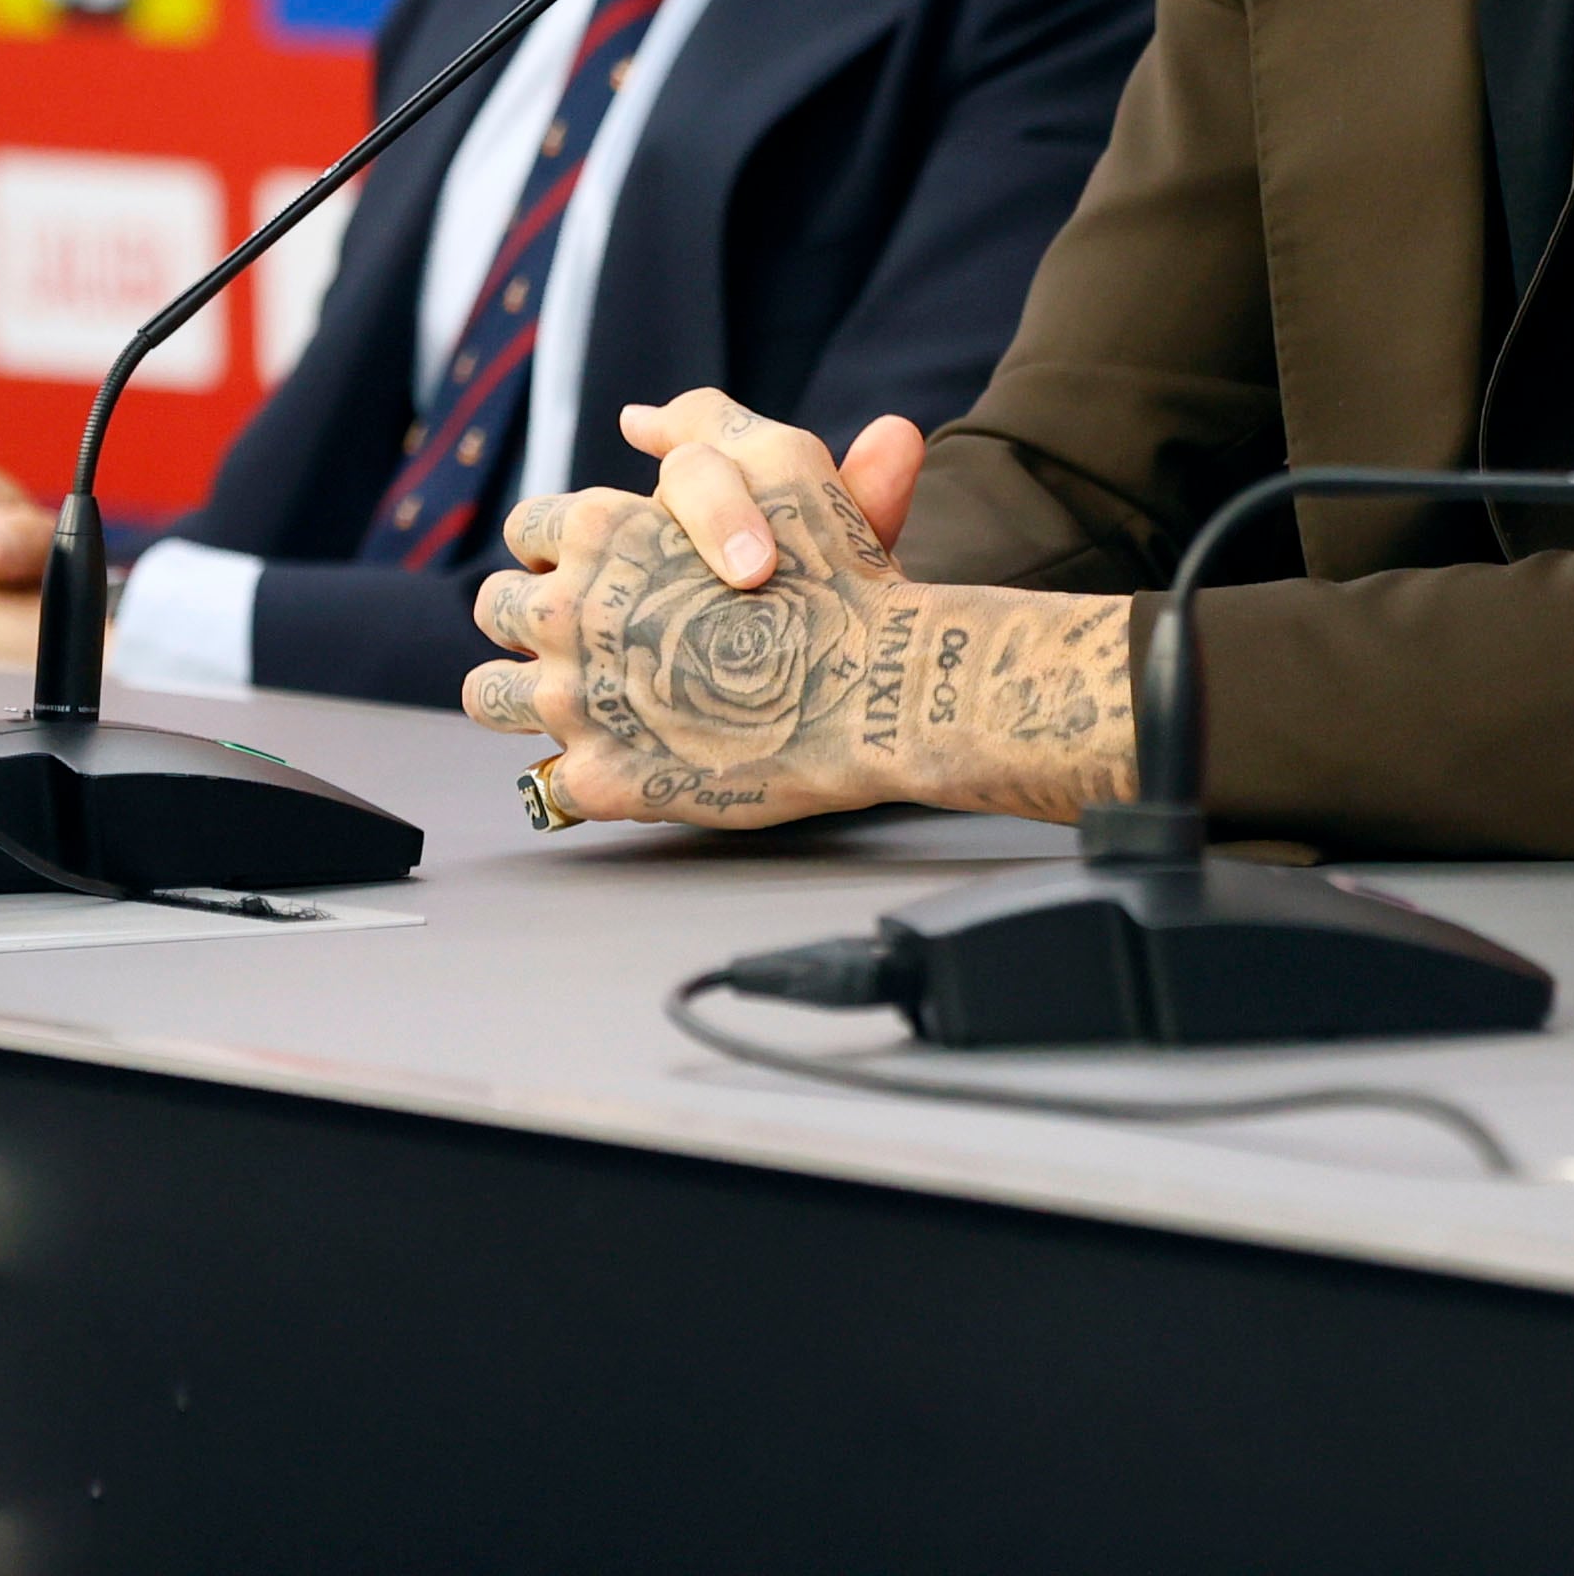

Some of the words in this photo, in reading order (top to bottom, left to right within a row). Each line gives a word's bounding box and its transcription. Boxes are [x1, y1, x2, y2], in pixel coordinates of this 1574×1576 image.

[861, 606, 919, 756] MMXIV
[928, 627, 969, 724] 06-05
[642, 766, 769, 814] Paqui
